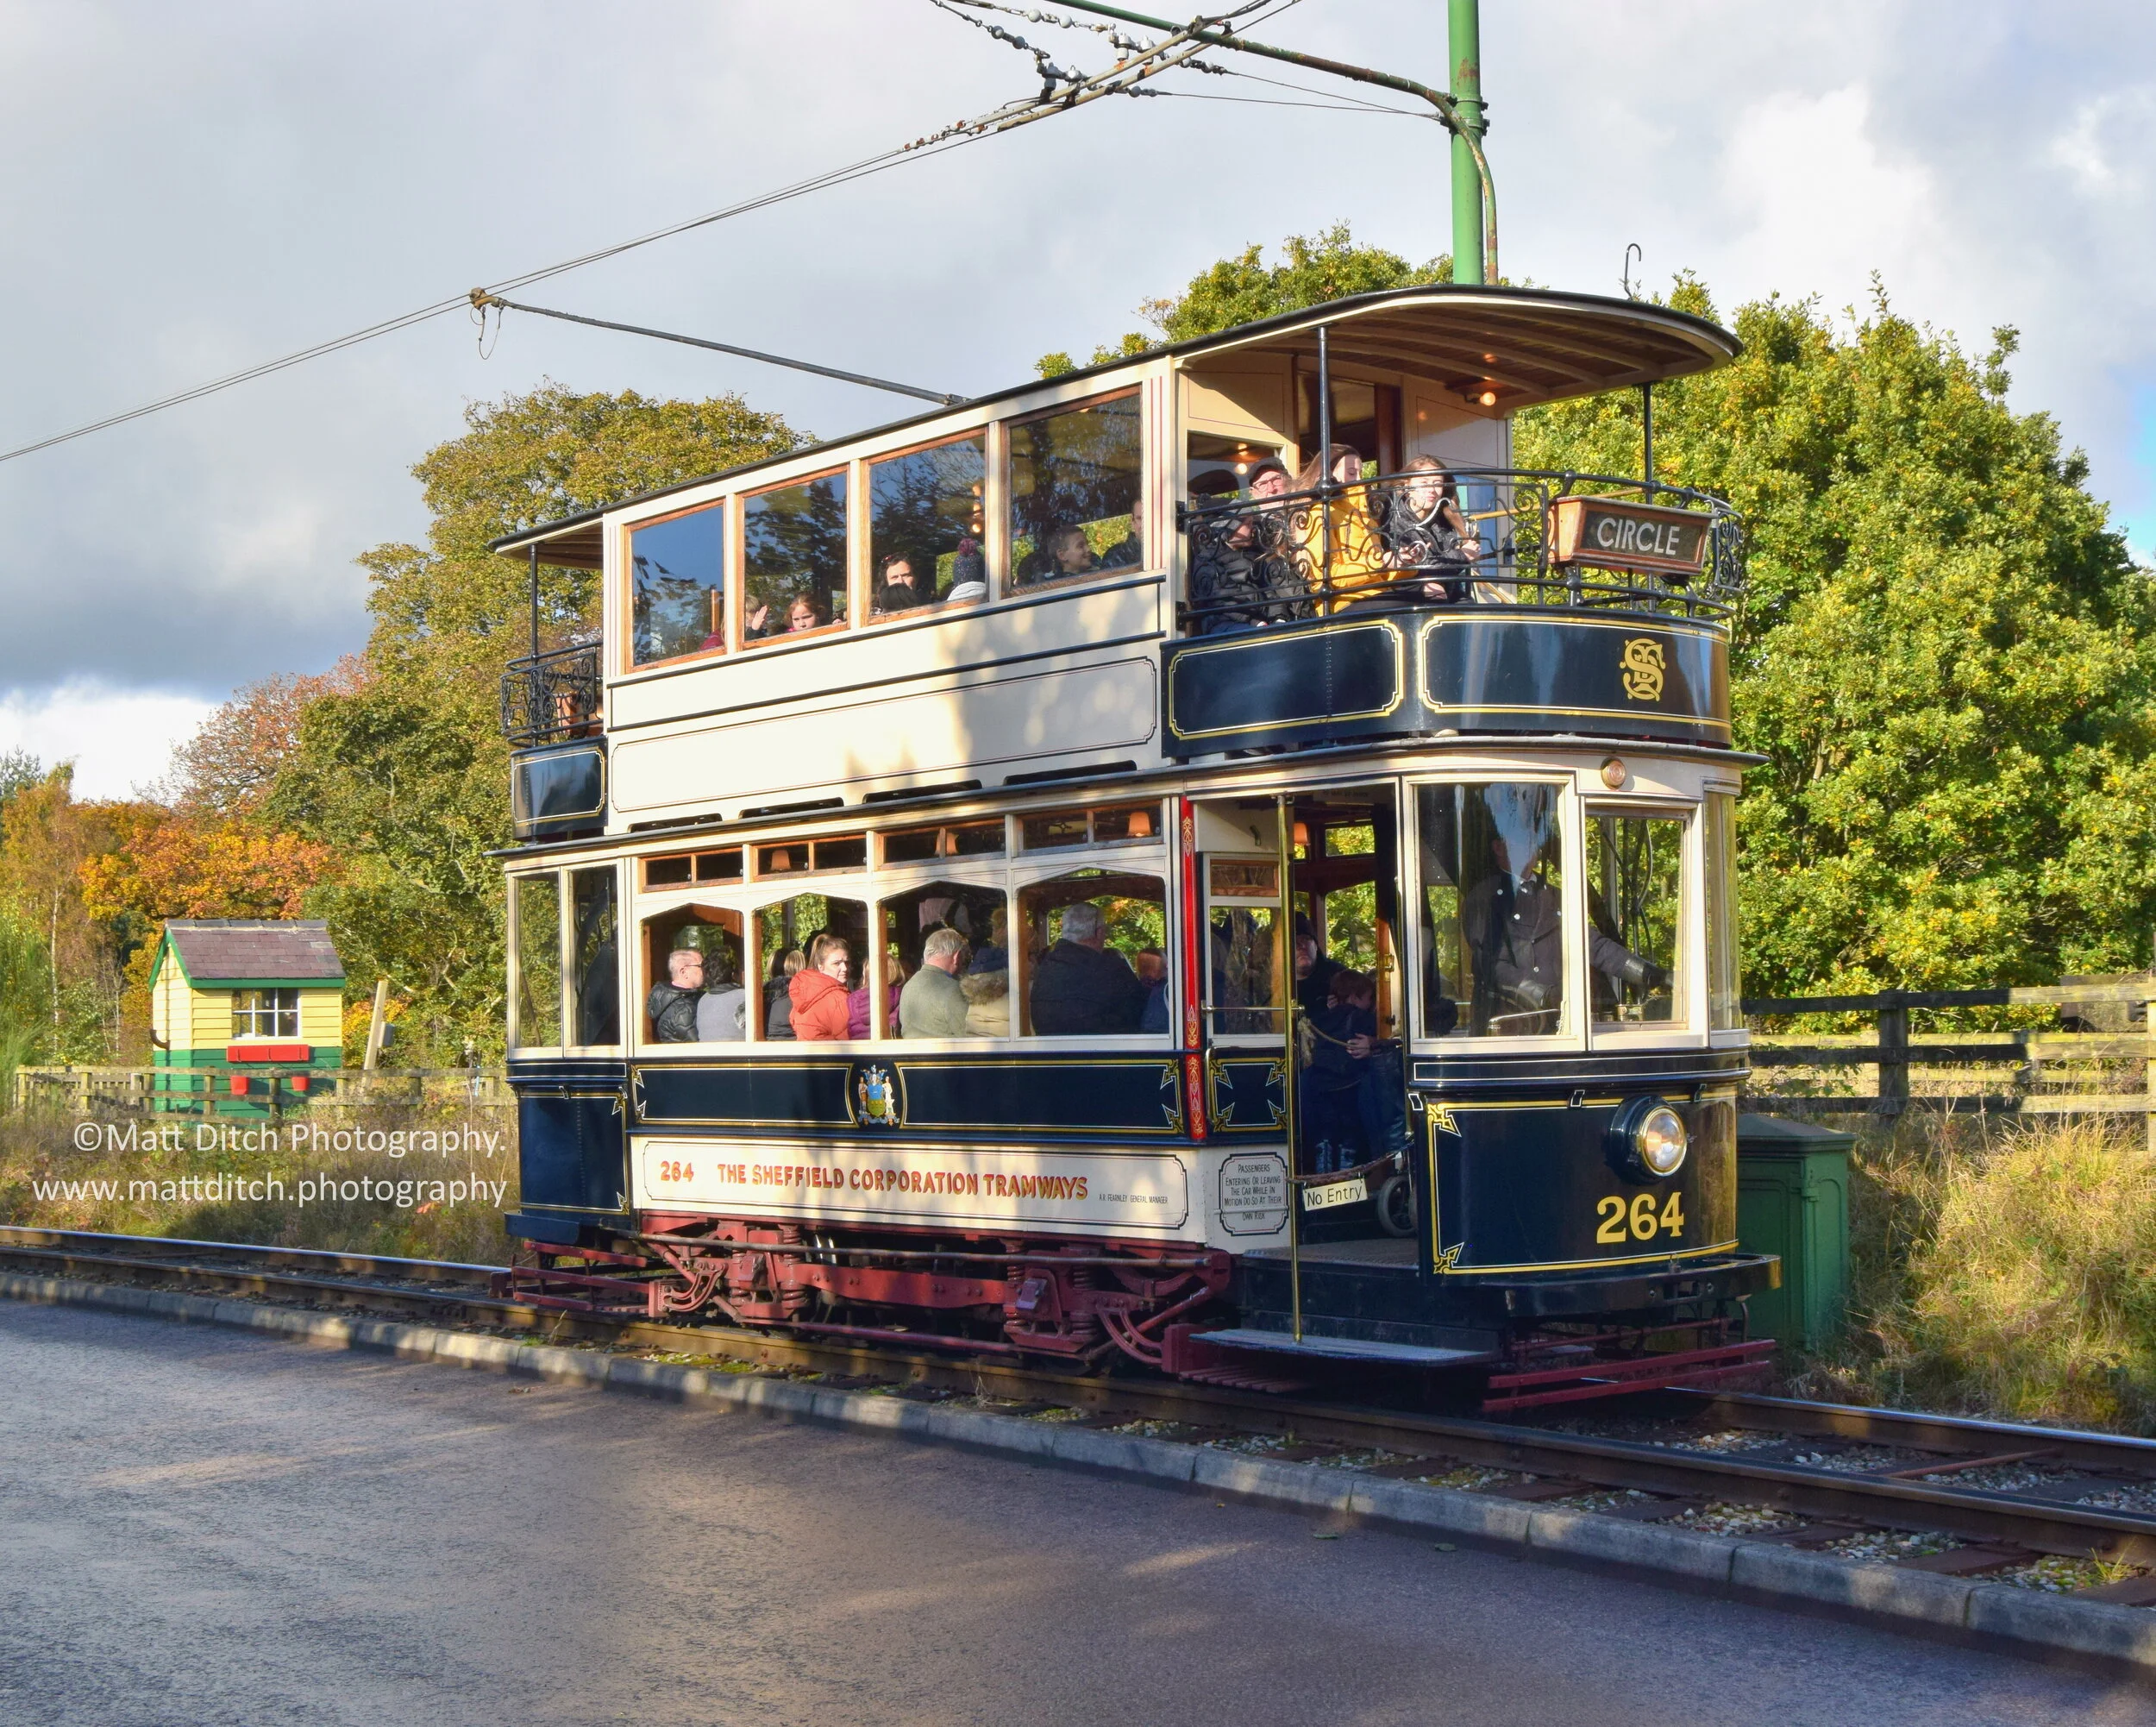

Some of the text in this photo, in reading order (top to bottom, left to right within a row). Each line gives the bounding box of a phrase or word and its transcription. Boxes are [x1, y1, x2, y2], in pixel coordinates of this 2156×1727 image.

[1597, 517, 1680, 556] CIRCLE
[1238, 1164, 1270, 1173] PASSENGERS
[660, 1160, 1088, 1200] 264 THE SHEFFIELD CORPORATION TRAMWAYS
[1225, 1176, 1282, 1186] ENTERING OR LEAVING
[1231, 1185, 1275, 1196] THE CAR WHILE IN
[1307, 1184, 1363, 1208] No Entry
[1107, 1193, 1127, 1203] FEARNLEY
[1130, 1195, 1148, 1203] GENERAL
[1150, 1196, 1168, 1204] MANAGER
[1225, 1196, 1282, 1206] MOTION DO SO AT THEIR
[1243, 1211, 1265, 1221] OWN RISK
[1596, 1191, 1684, 1244] 264
